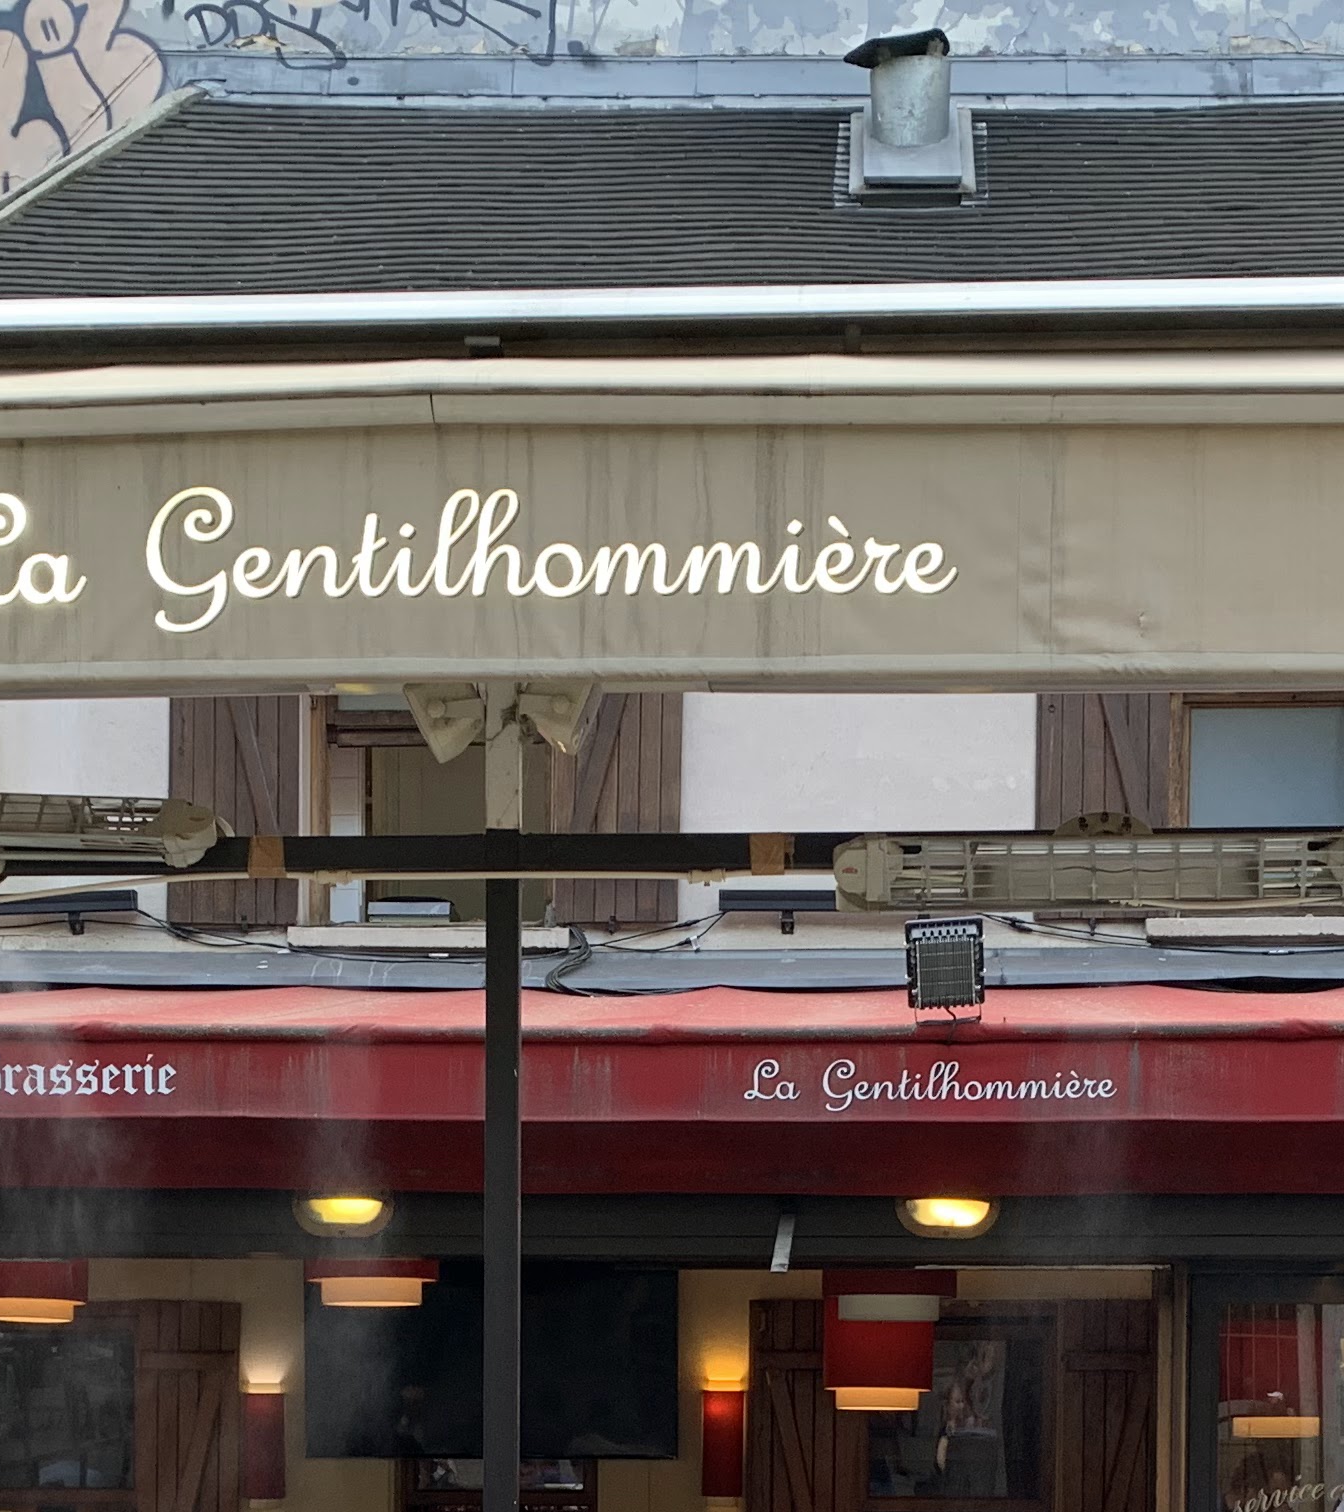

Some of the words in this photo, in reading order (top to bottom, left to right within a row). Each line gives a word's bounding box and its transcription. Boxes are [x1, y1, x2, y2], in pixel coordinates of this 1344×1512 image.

[144, 485, 958, 633] Gentilhommière
[743, 1058, 801, 1101] La
[822, 1058, 1118, 1112] Gentilhommière
